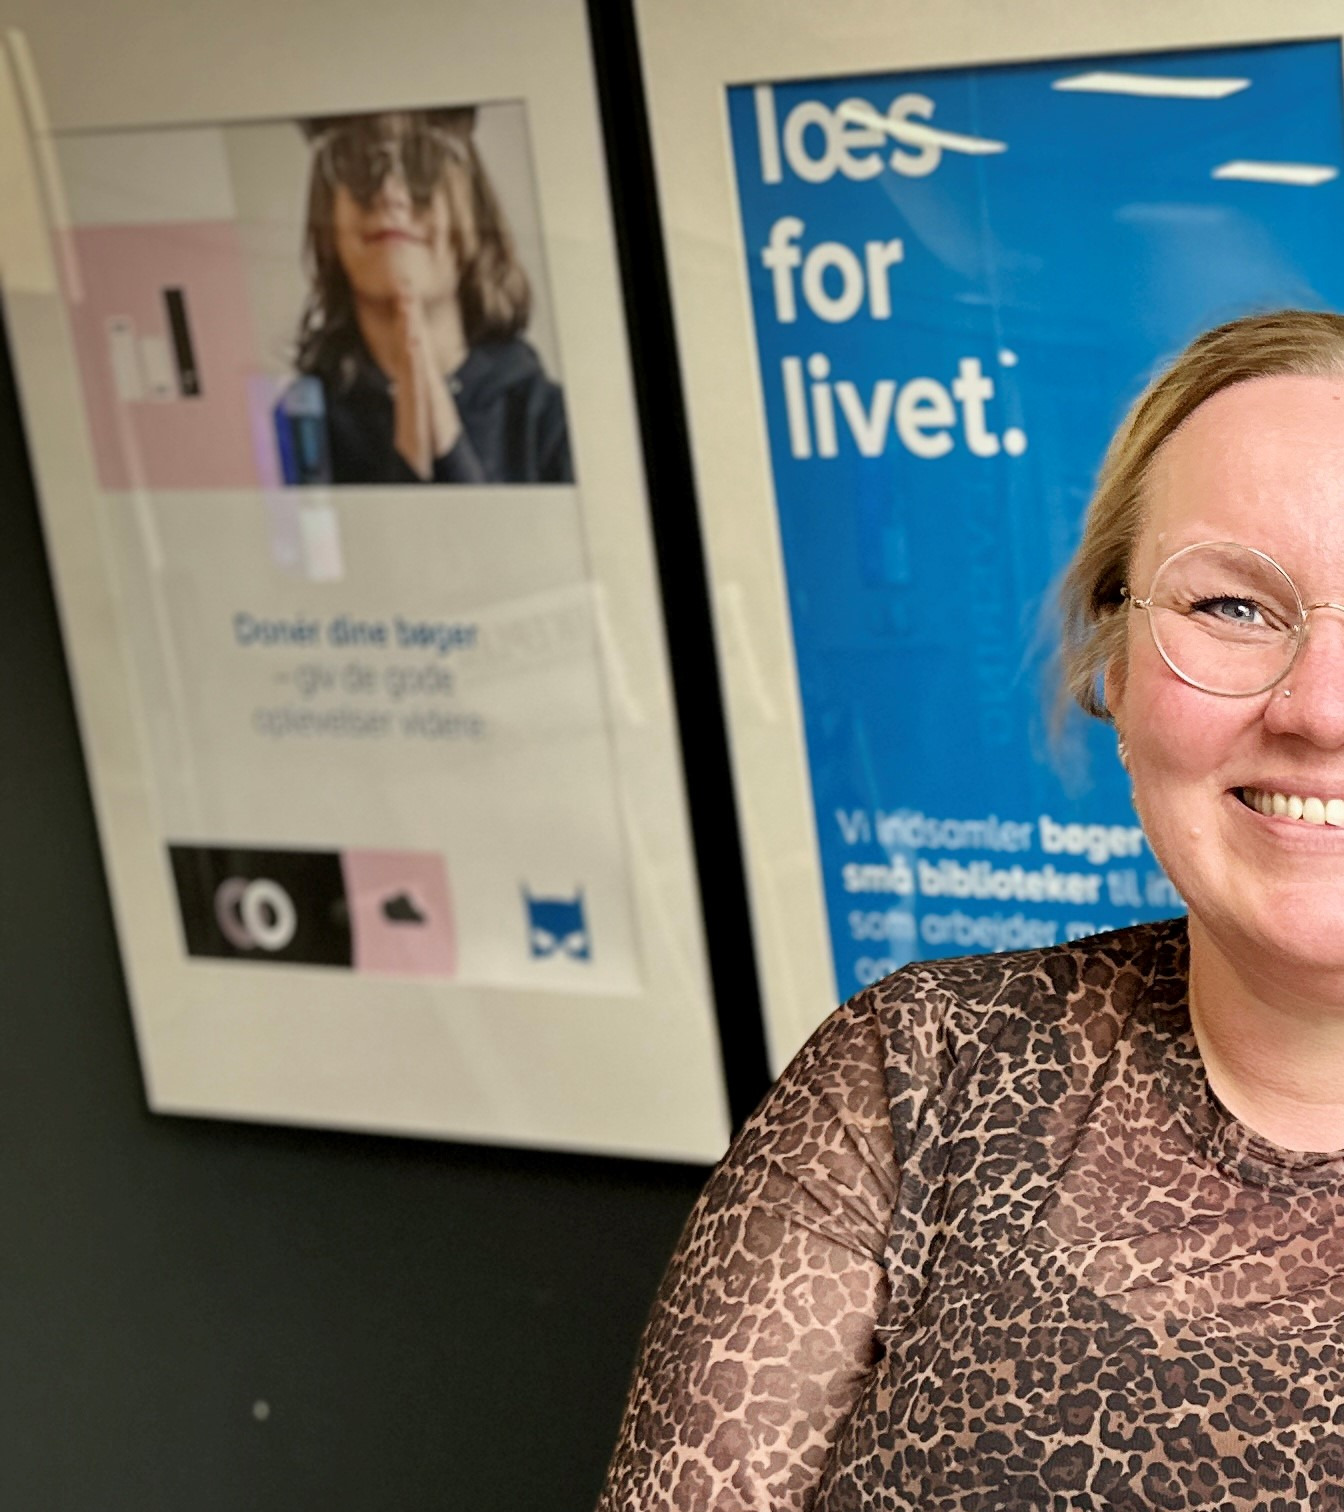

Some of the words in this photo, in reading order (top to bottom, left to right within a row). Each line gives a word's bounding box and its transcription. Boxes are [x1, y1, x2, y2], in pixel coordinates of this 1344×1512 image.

[754, 85, 942, 184] læs
[762, 217, 903, 323] for
[781, 353, 1027, 459] livet.
[328, 613, 387, 647] dine
[835, 807, 871, 846] Vi
[876, 807, 1034, 852] indsamler
[1038, 813, 1145, 866] bøger
[842, 852, 914, 897] små
[917, 857, 1102, 905] biblioteker
[848, 909, 916, 943] som
[920, 909, 1059, 952] arbejder
